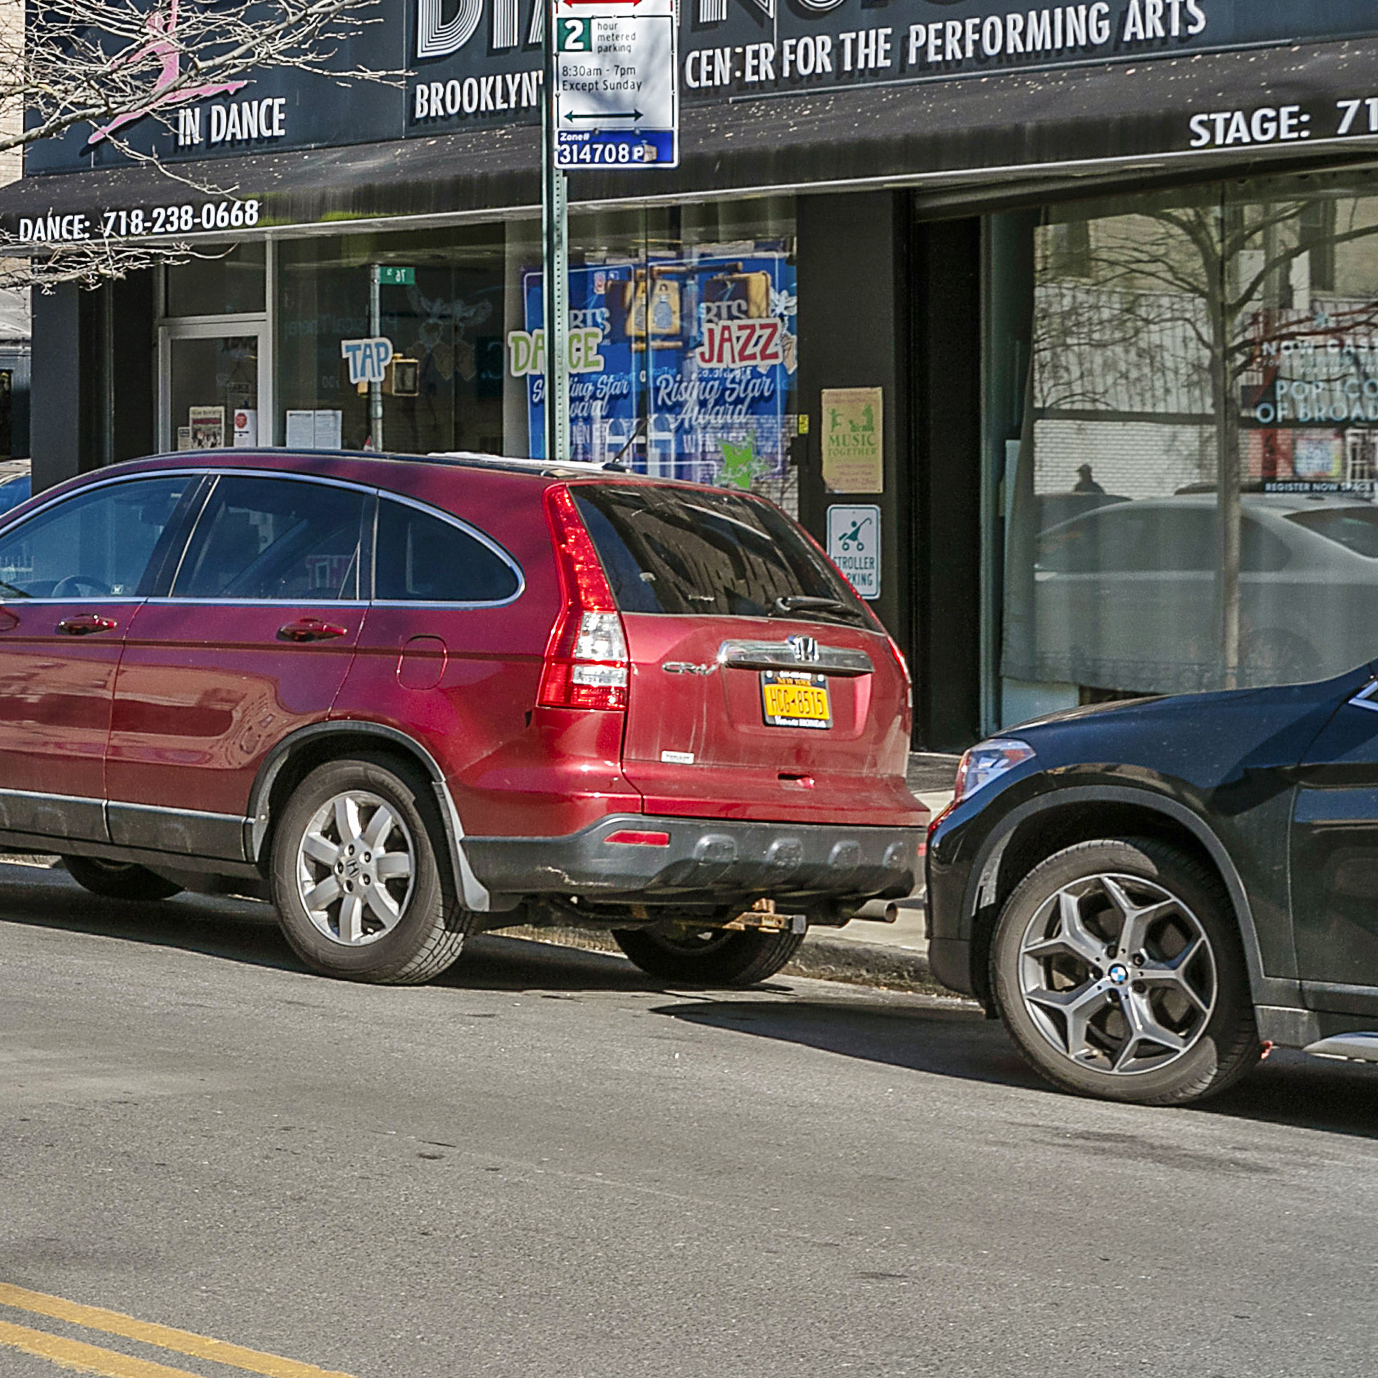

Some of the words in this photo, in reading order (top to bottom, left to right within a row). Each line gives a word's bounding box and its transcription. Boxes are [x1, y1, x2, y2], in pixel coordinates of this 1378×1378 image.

[564, 19, 584, 50] 2
[597, 22, 618, 30] hour
[597, 32, 636, 41] metered
[597, 43, 632, 54] parking
[414, 70, 543, 119] BROOKLYN'
[685, 42, 775, 88] CENER
[782, 35, 832, 78] FOR
[839, 27, 892, 71] THE
[908, 1, 1110, 65] PERFORMING
[562, 65, 602, 77] 8:30am
[614, 65, 636, 77] 7pm
[562, 80, 599, 93] Except
[603, 80, 643, 92] Sunday
[178, 107, 200, 146] IN
[210, 98, 286, 143] DANCE
[1189, 105, 1311, 147] STAGE:
[559, 132, 590, 141] Zone#
[559, 143, 630, 163] 314708
[19, 214, 90, 242] DANCE:
[103, 199, 259, 237] 718-238-0668
[510, 331, 602, 372] DACE
[699, 322, 780, 364] JAZZ
[344, 341, 390, 380] TAP
[1256, 402, 1288, 423] OF
[829, 433, 876, 447] MUSIC
[828, 447, 877, 457] TOGETHER
